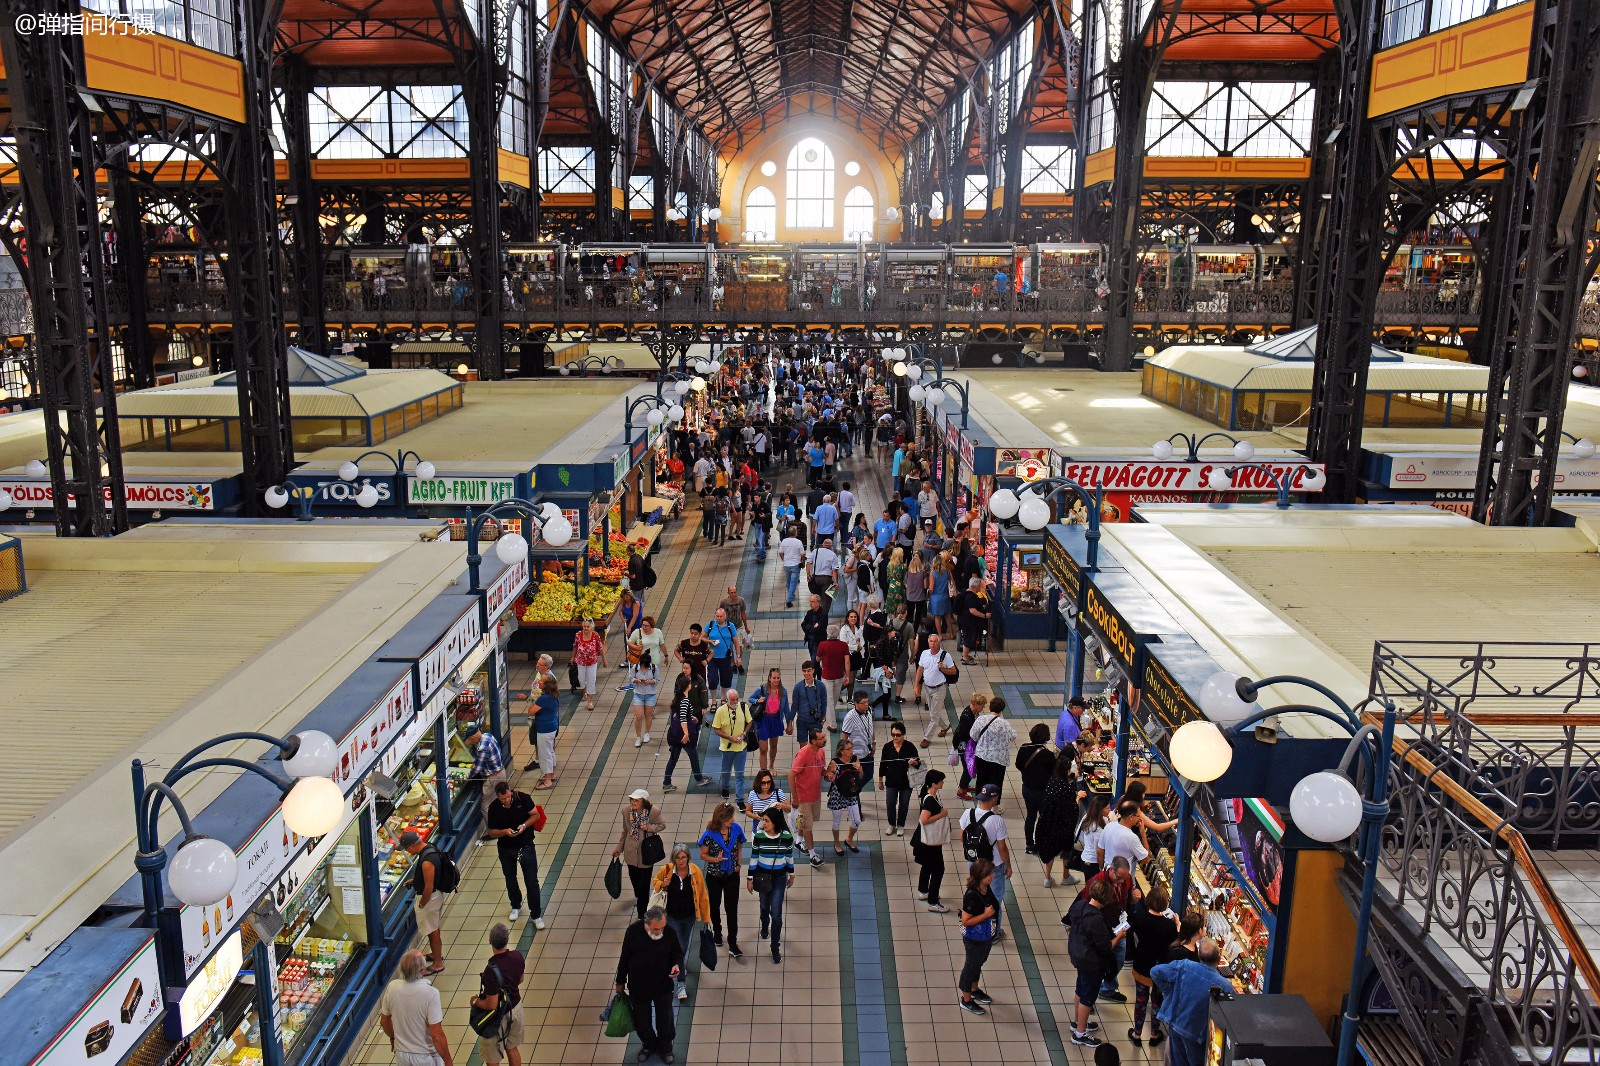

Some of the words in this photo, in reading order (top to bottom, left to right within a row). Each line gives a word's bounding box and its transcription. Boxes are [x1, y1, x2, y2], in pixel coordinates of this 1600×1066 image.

[1067, 463, 1191, 488] FELVÁGOTT
[103, 485, 185, 501] GÜMÖLCS
[318, 478, 391, 501] TOJS
[412, 479, 487, 501] AGRO-FRUIT
[1129, 494, 1188, 504] KABANOS
[1145, 666, 1179, 717] Chocolate
